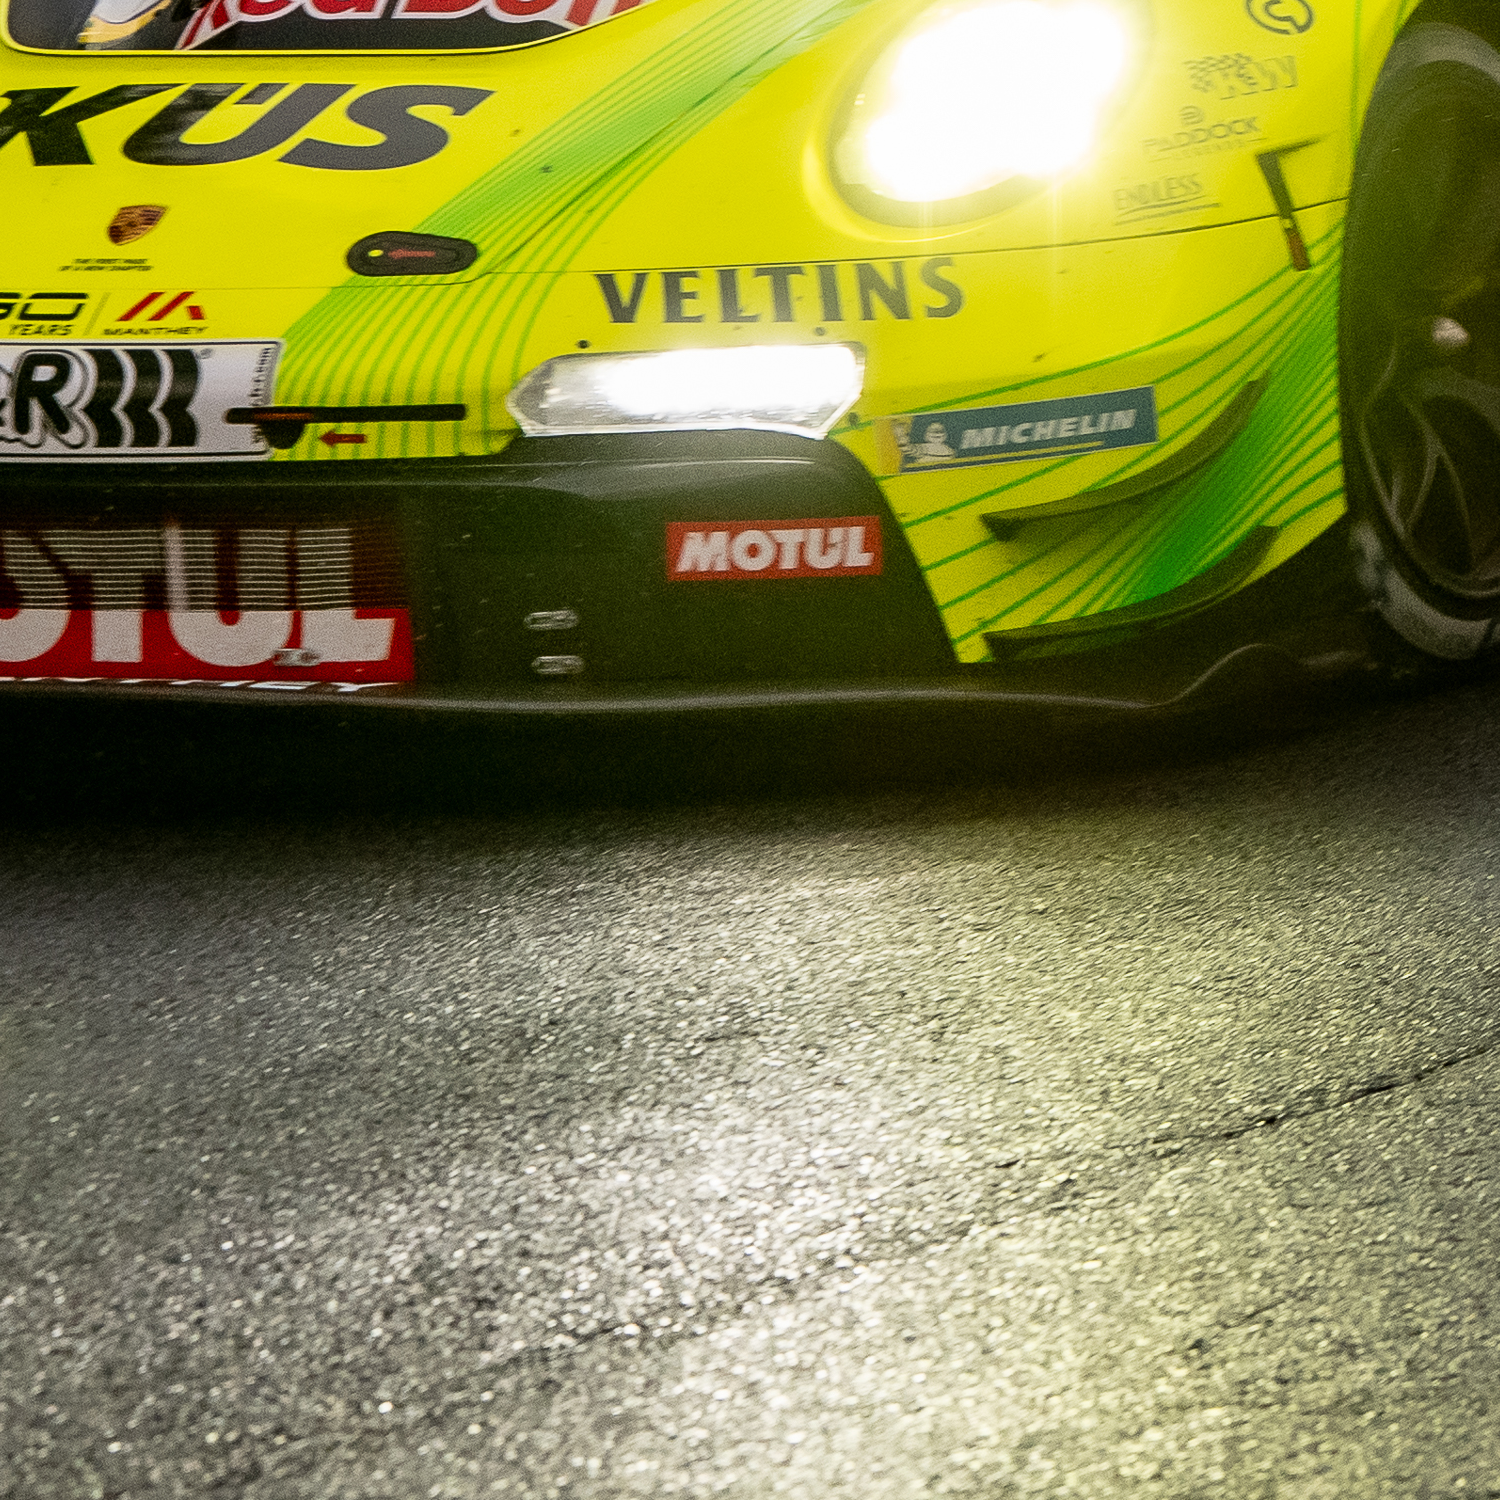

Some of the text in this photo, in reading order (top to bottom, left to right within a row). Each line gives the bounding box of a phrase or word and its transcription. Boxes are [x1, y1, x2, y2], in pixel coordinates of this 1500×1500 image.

[595, 255, 966, 324] VELTINS
[7, 323, 74, 336] YEARS
[957, 407, 1137, 450] MICHELIN
[675, 524, 877, 574] MOTUL
